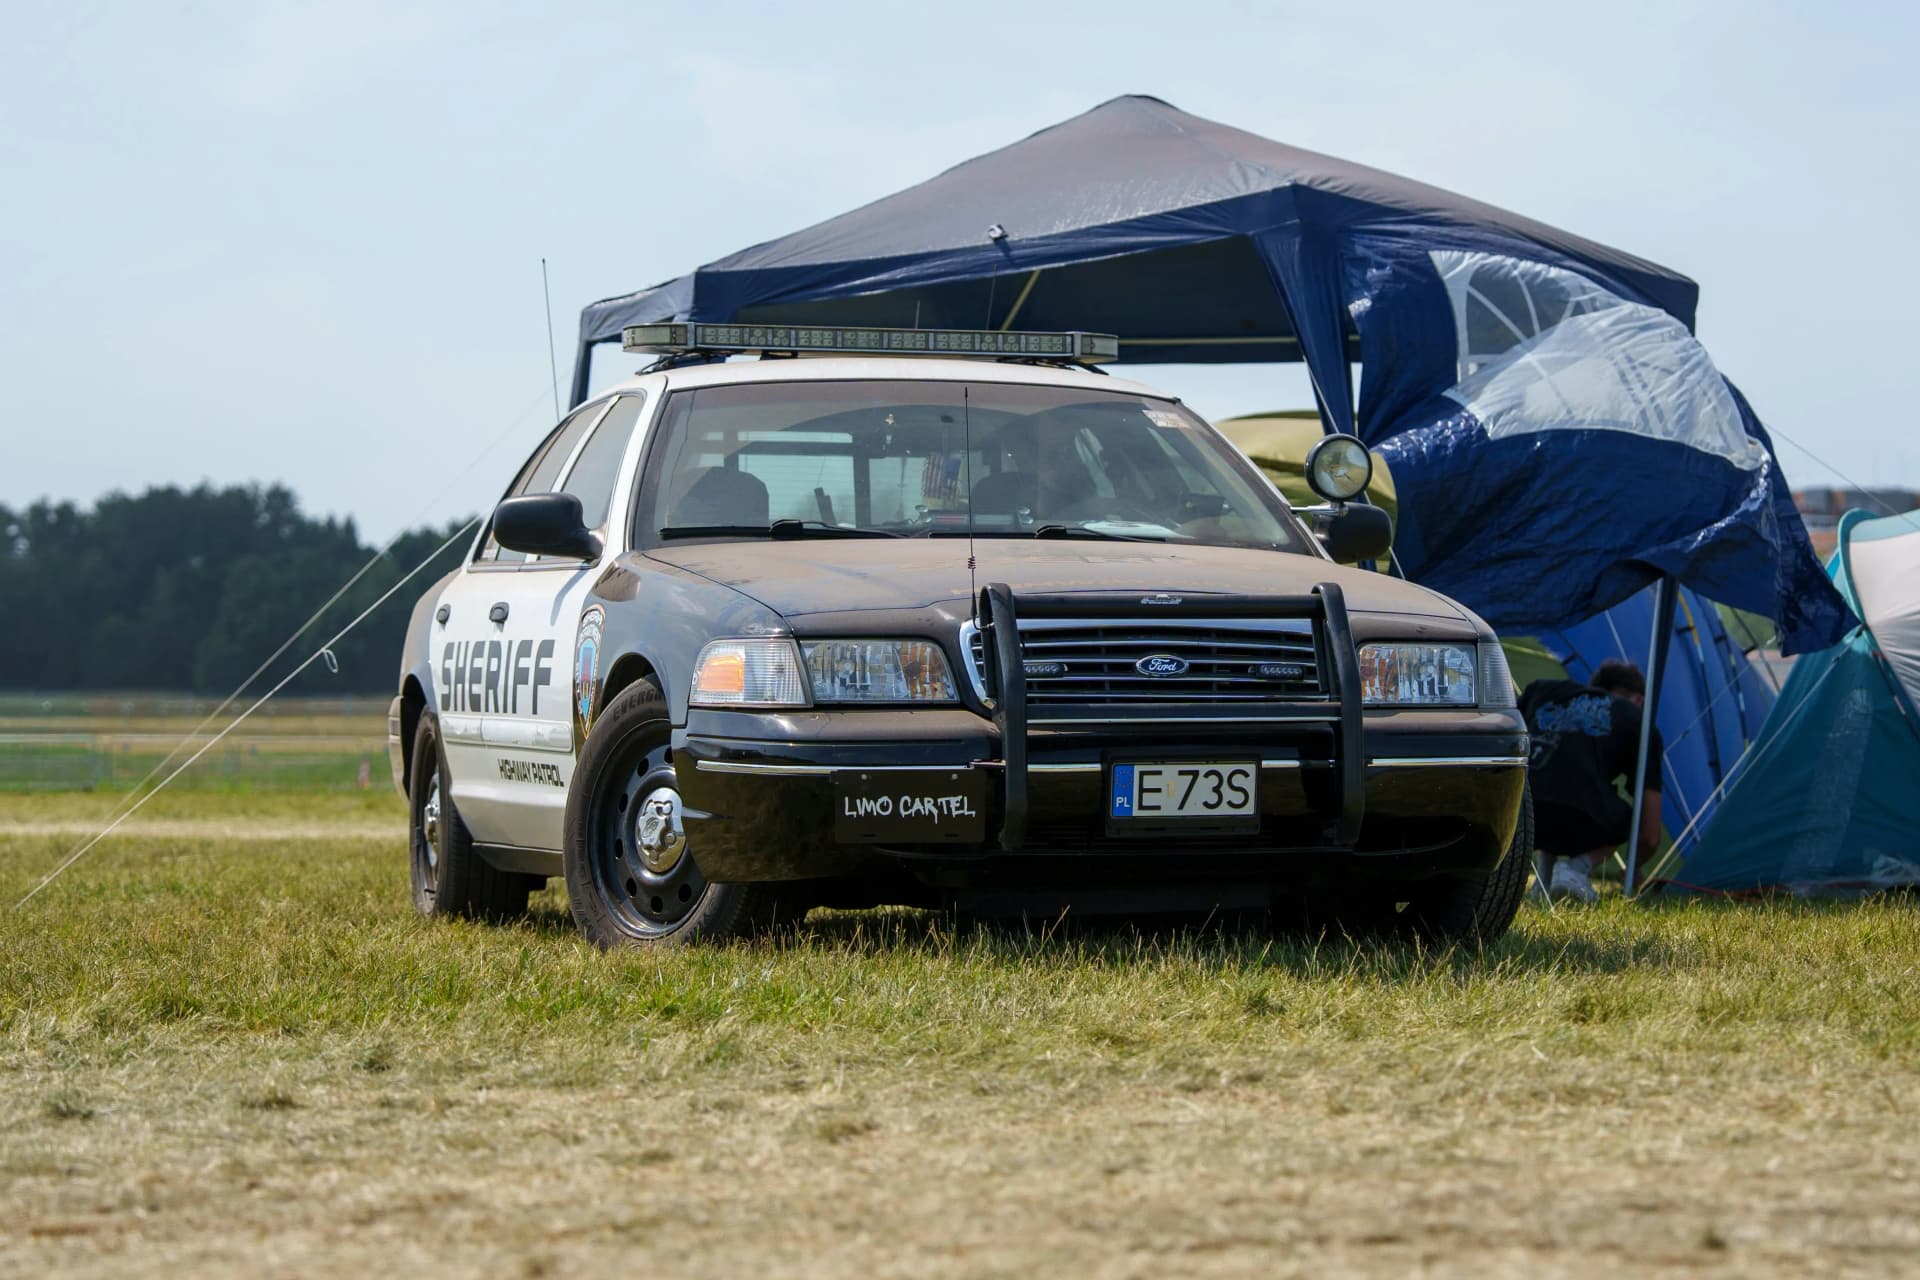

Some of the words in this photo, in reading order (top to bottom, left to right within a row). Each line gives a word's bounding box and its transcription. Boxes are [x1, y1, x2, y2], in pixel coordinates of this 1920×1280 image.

[441, 639, 555, 715] SHERIFF
[1149, 658, 1177, 671] Ford
[497, 758, 531, 783] HIGHWAY
[531, 761, 565, 787] PATROL
[1115, 797, 1130, 808] PL
[1137, 770, 1163, 811] E
[1177, 769, 1250, 810] 73S
[844, 795, 893, 818] LIMO
[899, 795, 976, 825] CARTEL
